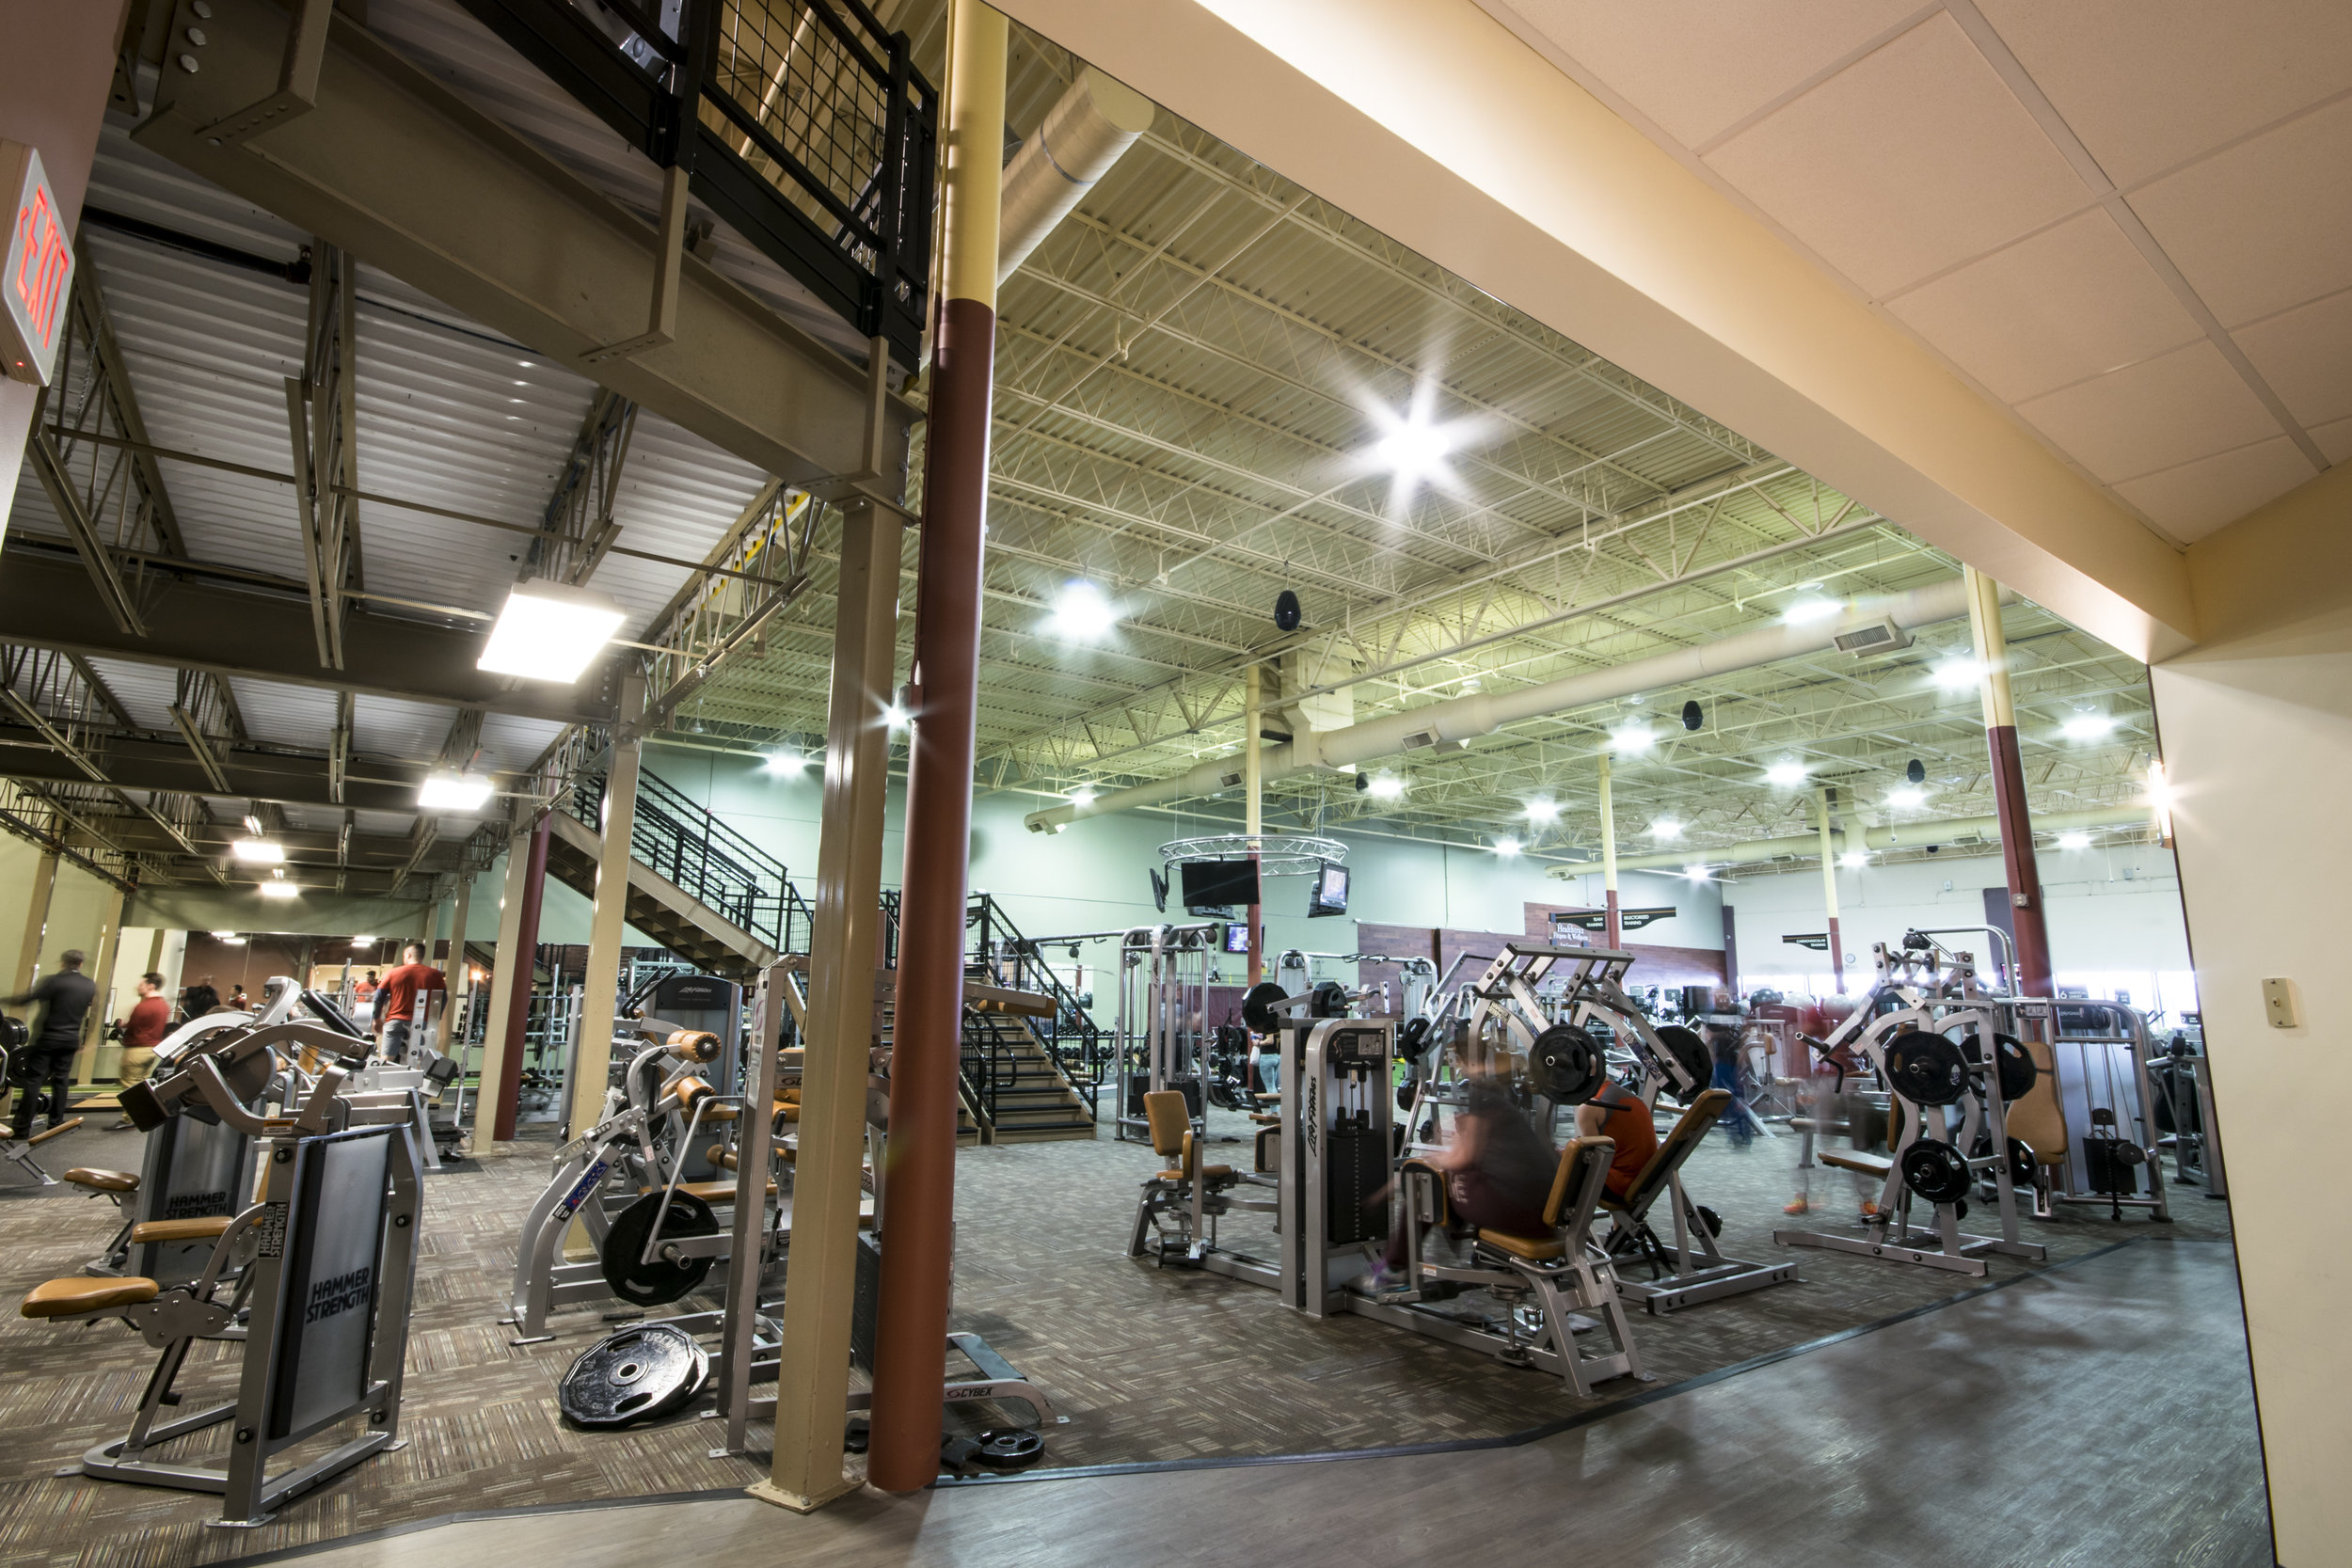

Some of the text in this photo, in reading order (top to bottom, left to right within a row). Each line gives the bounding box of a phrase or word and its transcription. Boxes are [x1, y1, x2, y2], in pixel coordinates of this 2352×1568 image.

[16, 183, 70, 350] EXIT
[2060, 990, 2068, 1000] 6
[1308, 1076, 1318, 1158] Life Fitness
[165, 1202, 228, 1220] STRENGTH
[170, 1192, 227, 1209] HAMMER
[259, 1205, 277, 1254] HAMMER
[270, 1203, 288, 1257] STRENGTH
[306, 1285, 370, 1324] STRENGTH
[311, 1266, 370, 1306] HAMMER
[961, 1386, 993, 1398] CYBEX
